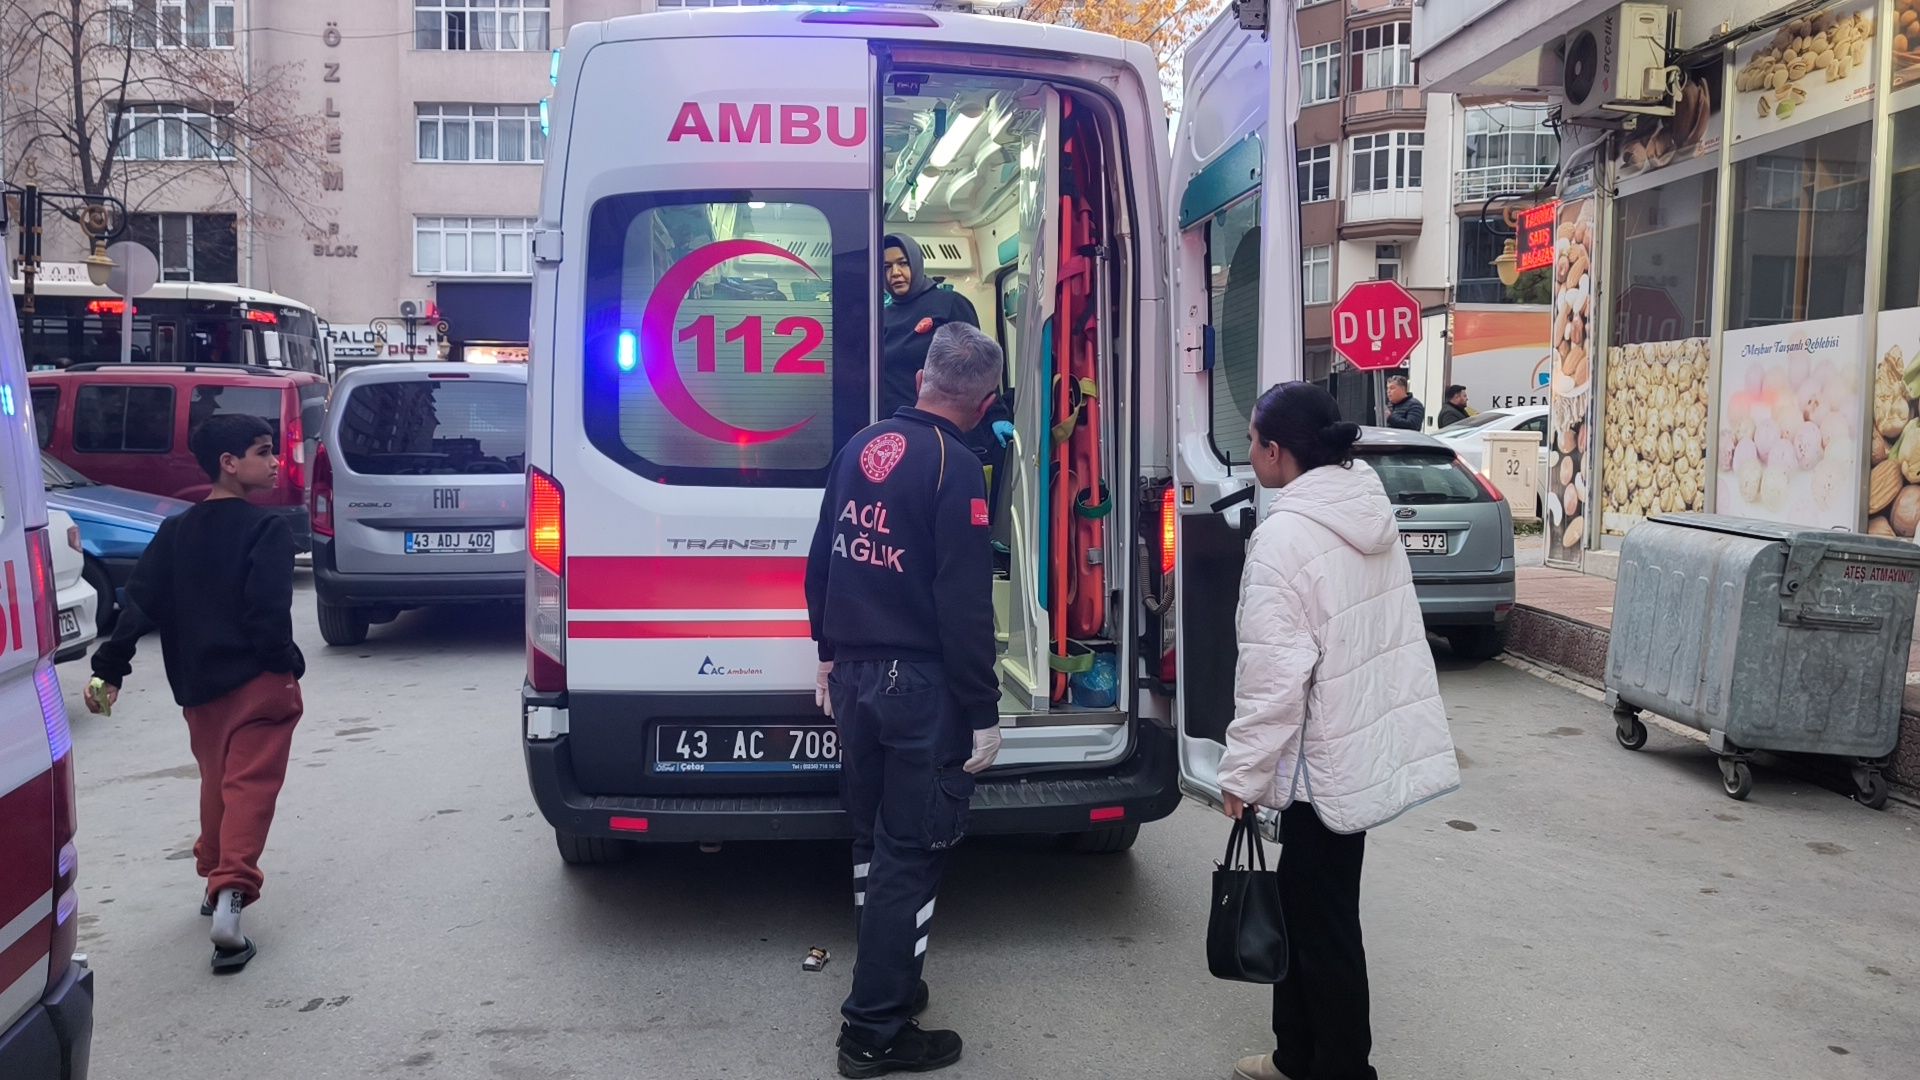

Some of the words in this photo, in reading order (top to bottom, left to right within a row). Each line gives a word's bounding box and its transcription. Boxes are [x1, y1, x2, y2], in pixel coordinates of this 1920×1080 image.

[323, 22, 344, 191] ÖZLEM
[667, 101, 867, 147] AMBU
[313, 244, 358, 258] BLOK
[1522, 246, 1555, 268] MAĞAZAS
[1339, 307, 1413, 344] DUR
[678, 315, 825, 373] 112
[1506, 459, 1520, 475] 32
[433, 488, 461, 509] FIAT
[838, 500, 890, 534] ACİL
[414, 534, 429, 547] 43
[437, 534, 460, 547] ADJ
[468, 534, 491, 547] 402
[666, 538, 798, 551] TRANSIT
[1422, 534, 1445, 548] 973
[831, 531, 906, 573] AĞLIK
[1844, 565, 1866, 582] ATEŞ
[711, 666, 725, 676] AC
[676, 730, 708, 759] 43
[733, 730, 764, 759] AC
[789, 730, 837, 759] 708
